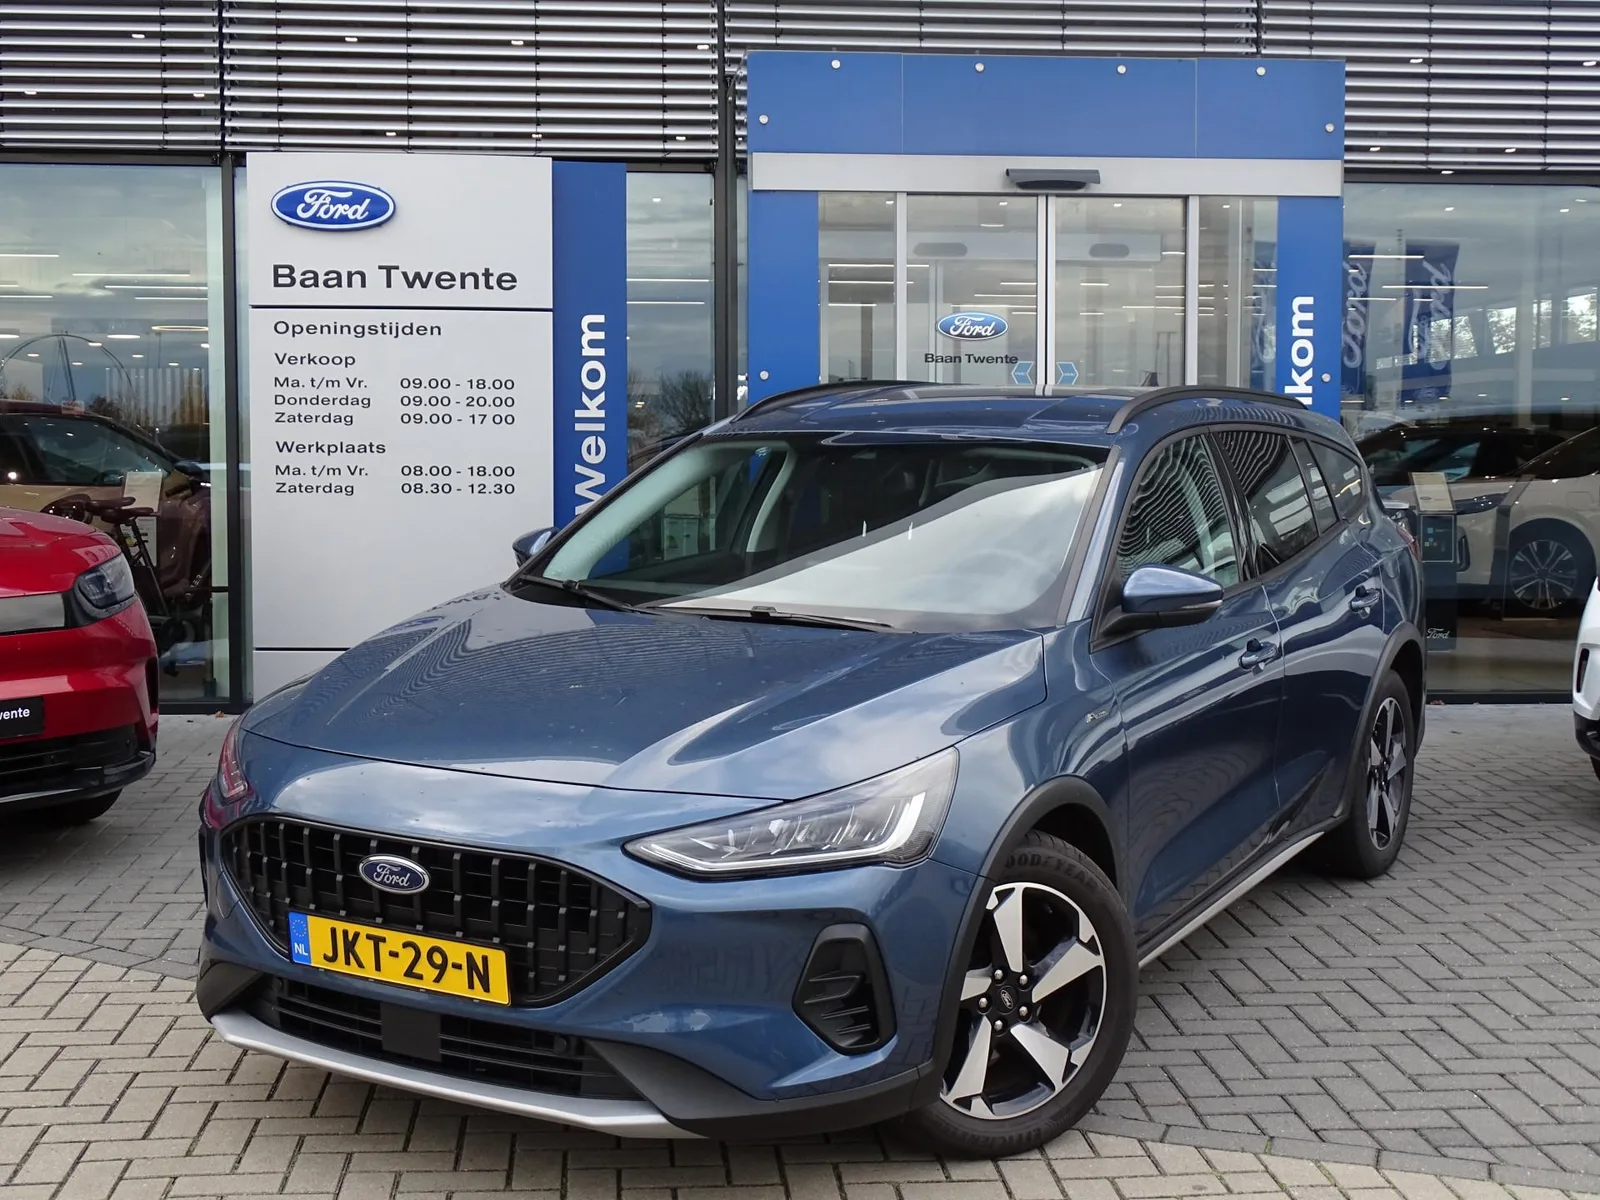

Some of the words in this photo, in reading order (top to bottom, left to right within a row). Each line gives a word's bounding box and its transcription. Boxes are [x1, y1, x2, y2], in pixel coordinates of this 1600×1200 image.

[296, 188, 371, 220] Ford
[272, 264, 367, 289] Baan
[377, 264, 518, 291] Twente
[1408, 260, 1452, 370] Frd
[273, 320, 442, 338] Openingstijden
[949, 315, 997, 336] Ford
[274, 352, 356, 368] Verkoop
[924, 353, 962, 363] Baan
[965, 353, 1019, 364] Twente
[274, 376, 306, 388] Ma.
[309, 376, 341, 389] t/m
[345, 376, 368, 388] Vr.
[400, 377, 451, 389] 09.00
[467, 379, 515, 390] 18.00
[274, 394, 371, 409] Donderdag
[400, 395, 451, 407] 09.00
[465, 396, 515, 407] 20.00
[274, 411, 354, 426] Zaterdag
[400, 413, 452, 424] 09.00
[574, 314, 606, 516] Welkom
[275, 441, 387, 456] Werkplaats
[275, 465, 306, 476] Ma.
[311, 465, 342, 477] t/m
[347, 465, 369, 476] Vr.
[401, 465, 452, 477] 08.00
[467, 466, 515, 477] 18.00
[275, 482, 354, 496] Zaterdag
[401, 483, 452, 494] 08.30
[468, 483, 515, 495] 12.30
[1427, 628, 1450, 639] Ford
[373, 863, 410, 888] Ford
[1004, 852, 1099, 890] OODYEAR
[294, 942, 309, 956] NL
[323, 927, 490, 994] JKT-29-N
